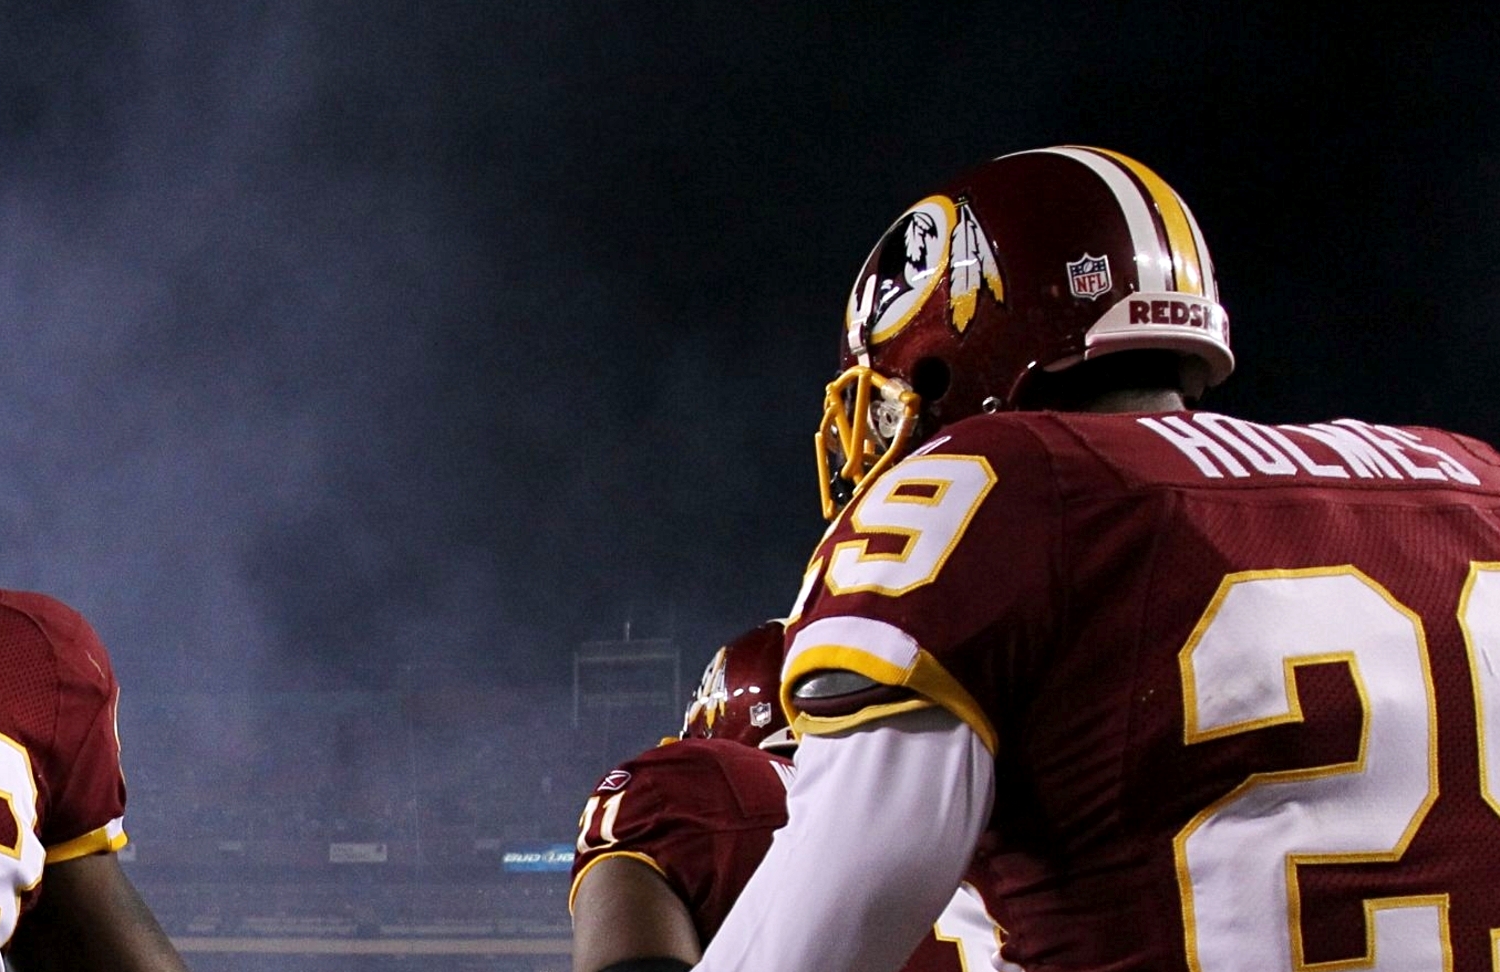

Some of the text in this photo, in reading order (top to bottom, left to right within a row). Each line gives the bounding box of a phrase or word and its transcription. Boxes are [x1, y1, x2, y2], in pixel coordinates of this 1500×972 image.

[1075, 274, 1106, 293] NFL
[1136, 412, 1481, 486] HOLMES
[784, 453, 999, 635] 9
[503, 853, 541, 863] BUD
